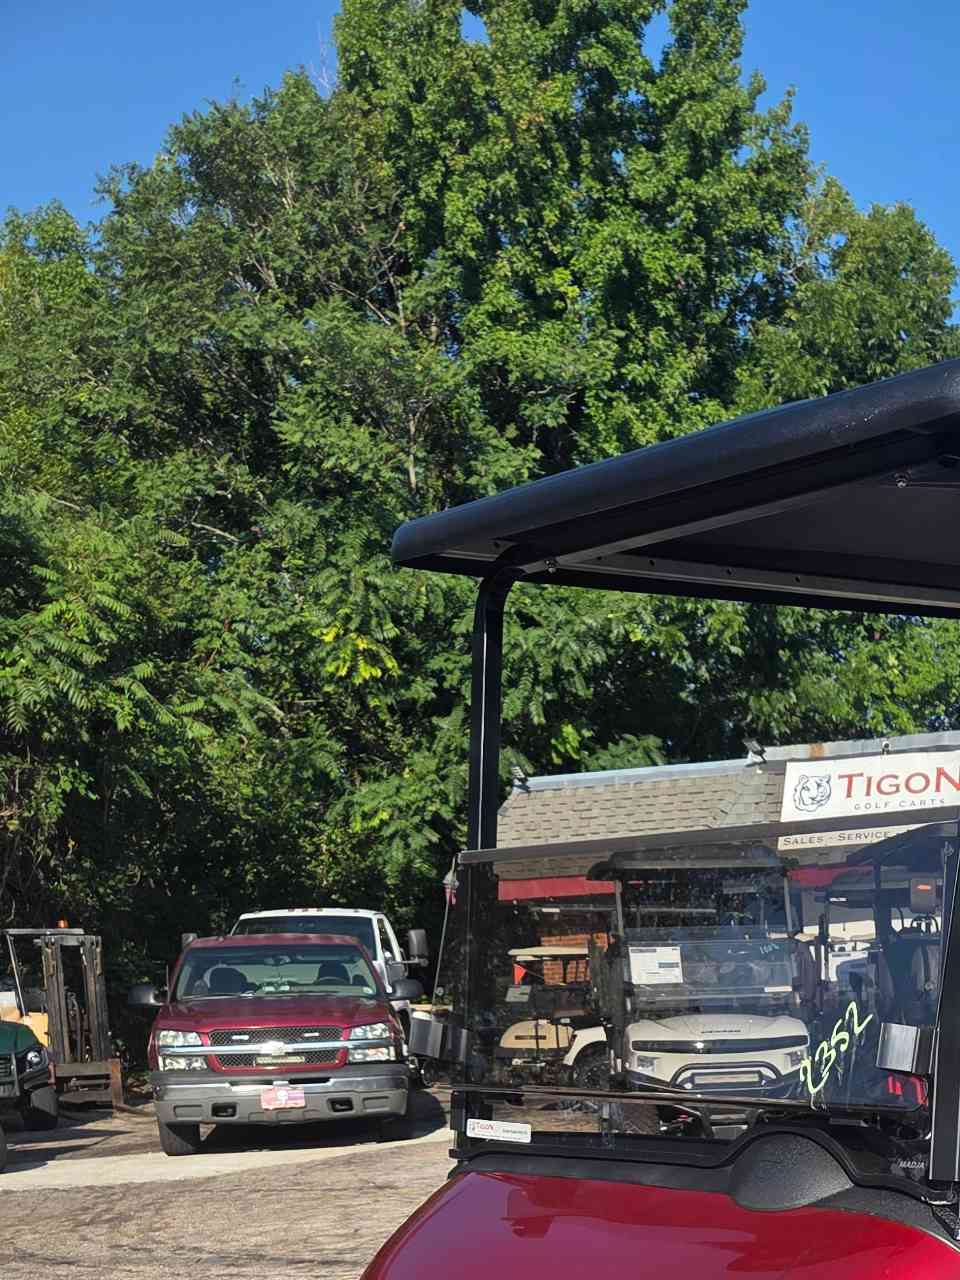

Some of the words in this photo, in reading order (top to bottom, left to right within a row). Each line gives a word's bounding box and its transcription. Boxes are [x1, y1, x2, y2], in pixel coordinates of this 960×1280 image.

[854, 801, 890, 811] GOLF
[899, 798, 945, 808] CARTS
[783, 834, 824, 847] SALES
[837, 829, 891, 842] SERVICE
[800, 1001, 873, 1094] 2352
